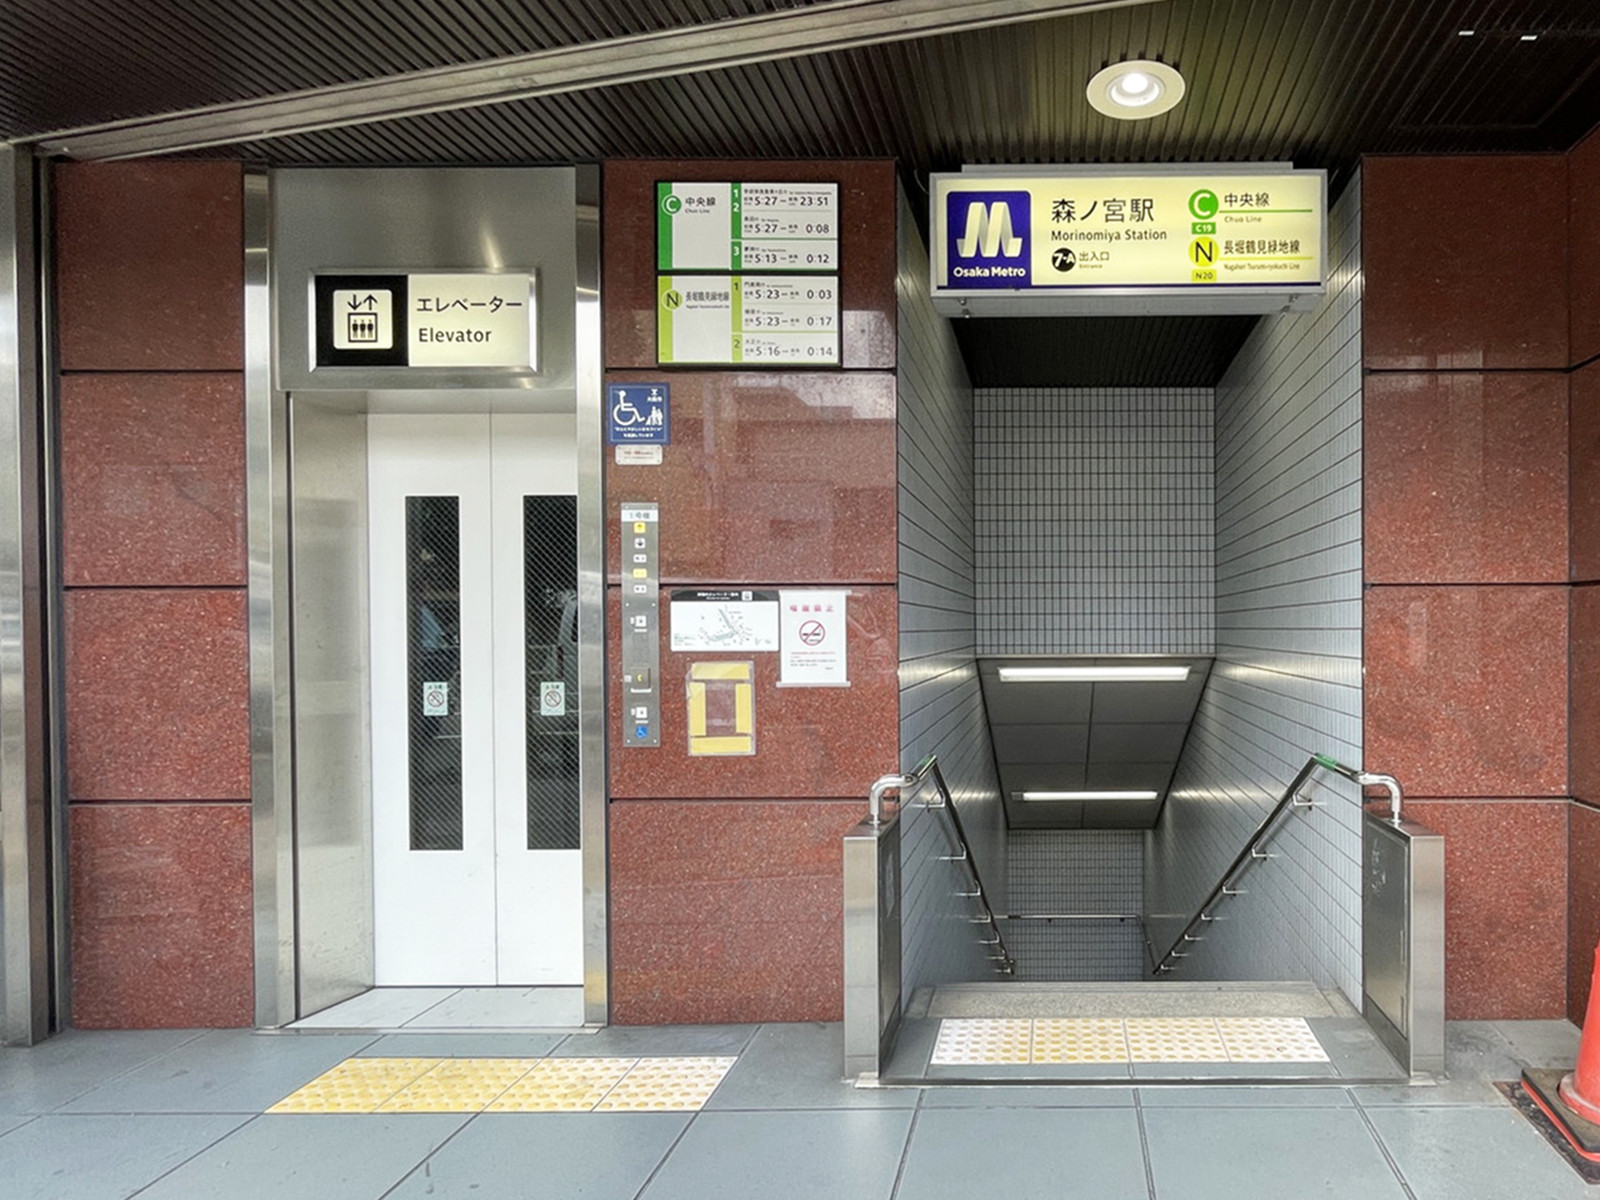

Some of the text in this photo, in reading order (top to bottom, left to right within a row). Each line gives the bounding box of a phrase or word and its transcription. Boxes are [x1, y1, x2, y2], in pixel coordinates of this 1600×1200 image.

[733, 189, 739, 198] 1
[685, 196, 716, 206] 中央線
[755, 196, 777, 206] 5:27
[800, 196, 828, 206] 23:51
[1224, 192, 1270, 207] 中央線
[733, 202, 739, 212] 2
[1052, 198, 1155, 223] 森ノ宮駅
[755, 223, 777, 233] 5:27
[806, 224, 829, 233] 0:08
[1195, 224, 1213, 233] C19
[1051, 228, 1168, 243] Morinomiya Station
[733, 246, 739, 256] 3
[1195, 241, 1213, 263] N
[1224, 240, 1301, 255] 長堀鶴見緑地線
[755, 254, 777, 263] 5:13
[806, 254, 829, 263] 0:12
[1079, 251, 1110, 262] 出入口
[953, 266, 1026, 278] Osaka Metro
[734, 282, 739, 291] 1
[755, 289, 780, 299] 5:23
[806, 289, 832, 299] 0:03
[416, 295, 523, 314] エレベーター
[755, 316, 780, 326] 5:23
[806, 317, 832, 326] 0:17
[418, 327, 492, 343] Elevator
[733, 340, 740, 348] 2
[756, 346, 780, 356] 5:16
[807, 346, 832, 356] 0:14
